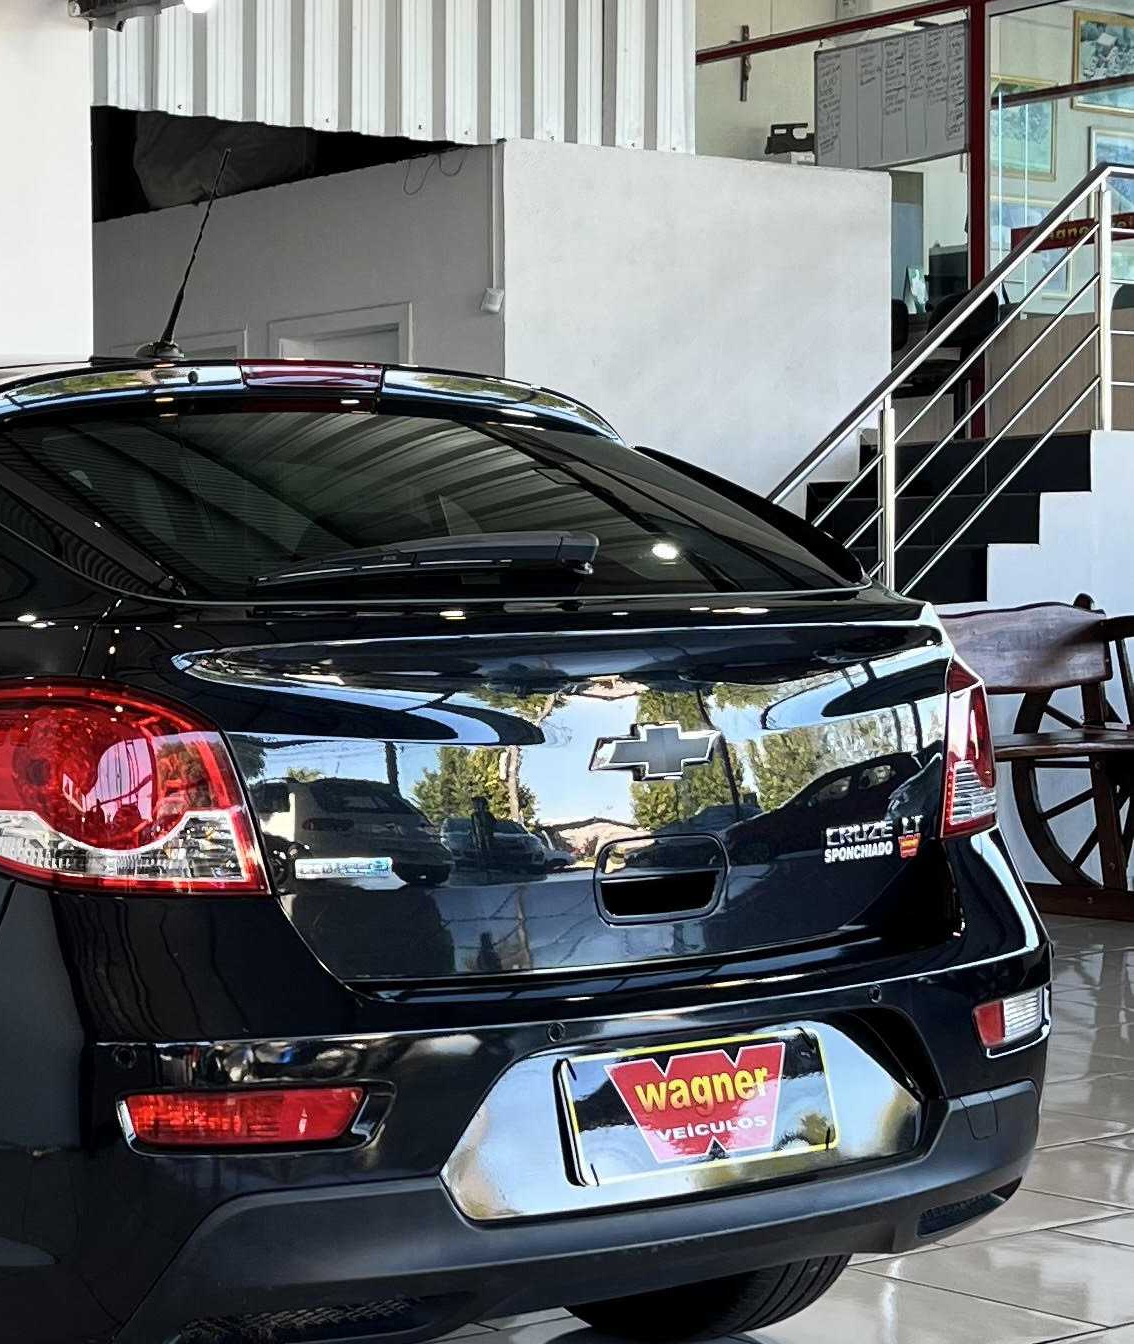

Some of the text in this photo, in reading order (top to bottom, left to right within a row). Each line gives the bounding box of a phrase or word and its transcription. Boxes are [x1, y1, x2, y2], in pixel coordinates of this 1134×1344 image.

[826, 820, 893, 846] CRUZE
[824, 840, 893, 863] SPONCHIADO
[634, 1066, 769, 1117] wagner
